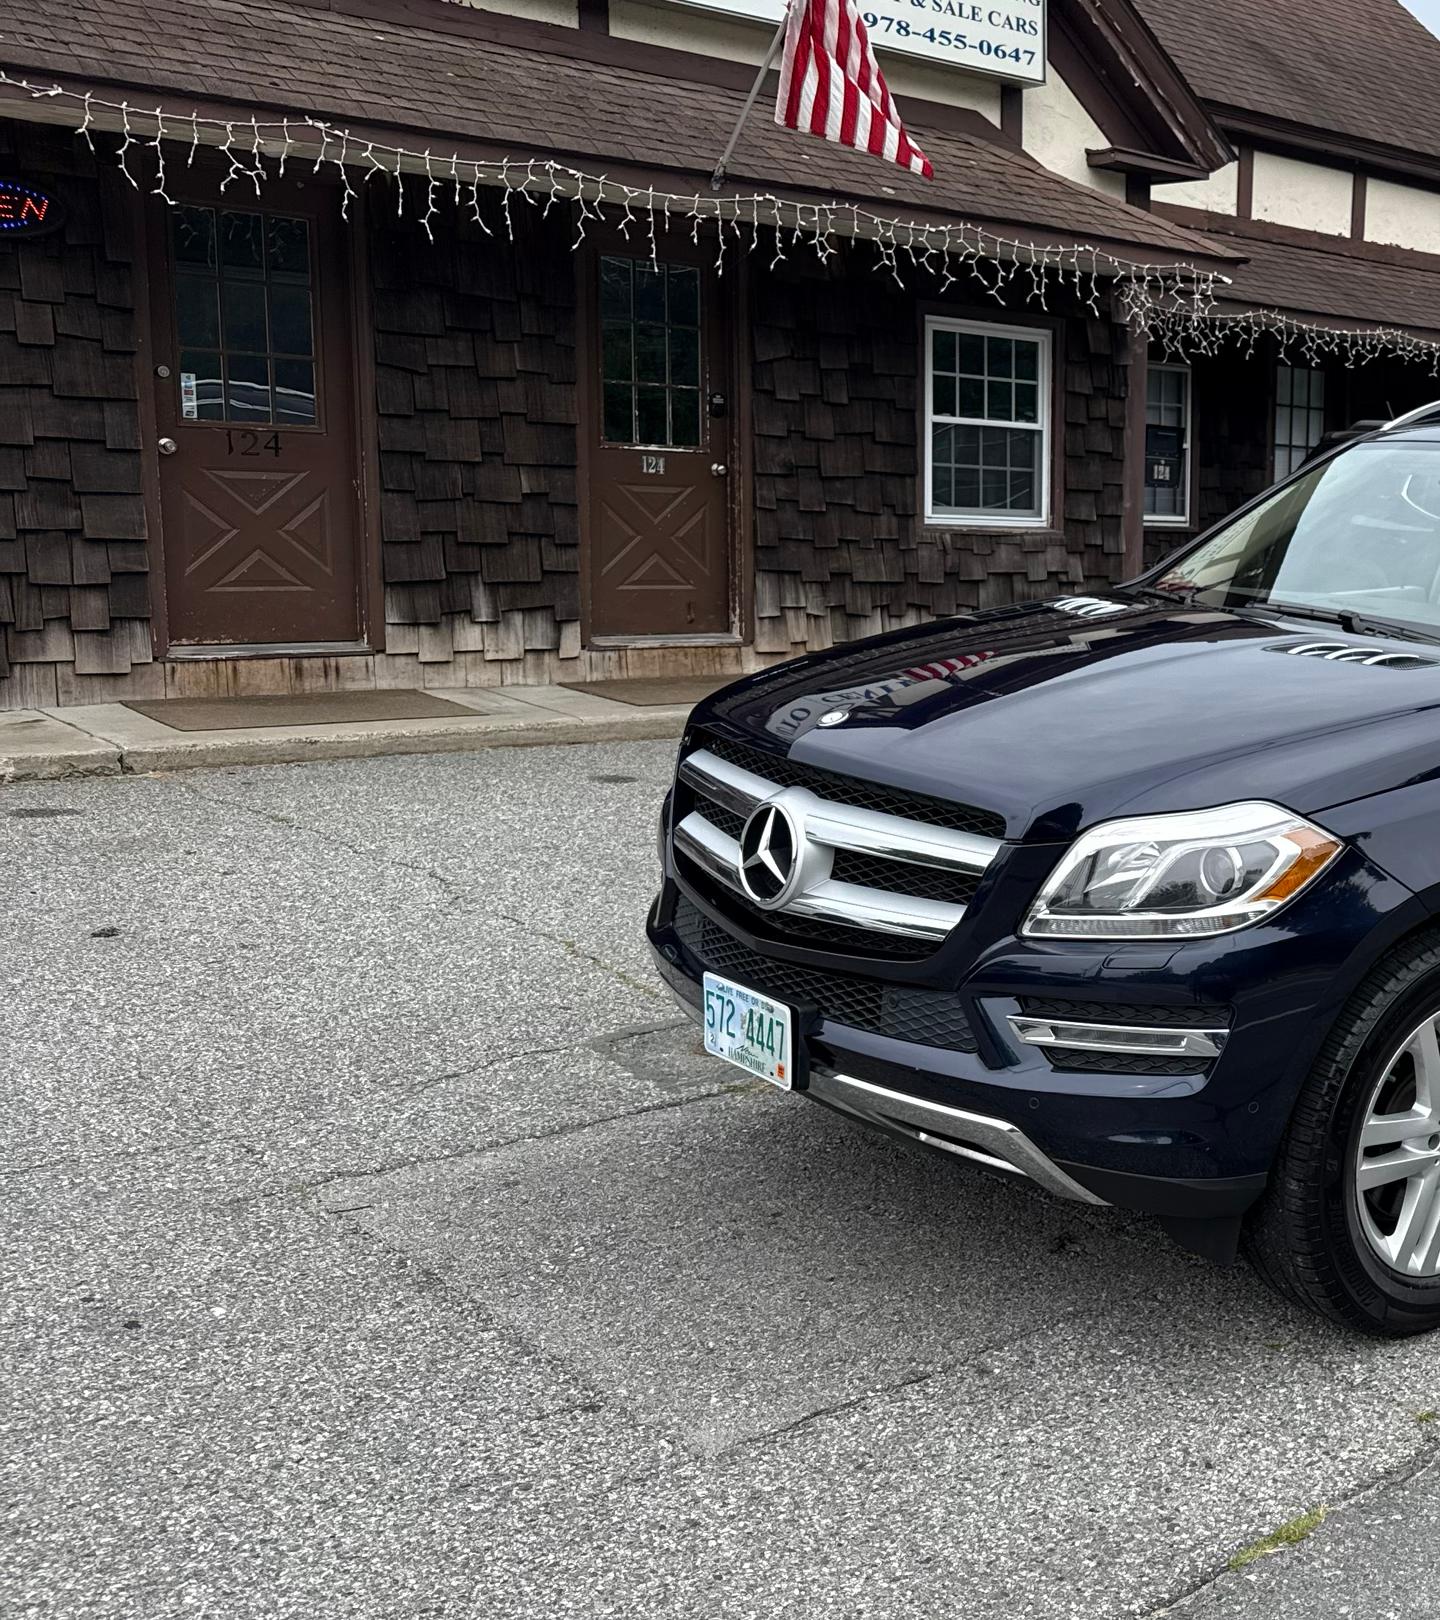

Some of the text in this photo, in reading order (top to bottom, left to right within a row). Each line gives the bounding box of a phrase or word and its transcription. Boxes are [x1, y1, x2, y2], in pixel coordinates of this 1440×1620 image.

[931, 0, 983, 22] SALE
[987, 10, 1039, 36] CARS
[862, 12, 1036, 66] 978-455-0647
[225, 430, 282, 458] 124
[641, 455, 665, 475] 124
[736, 990, 749, 1003] FREE
[751, 997, 760, 1007] OR
[706, 989, 785, 1060] 572 4447
[728, 1046, 767, 1074] HAMPSHIRE
